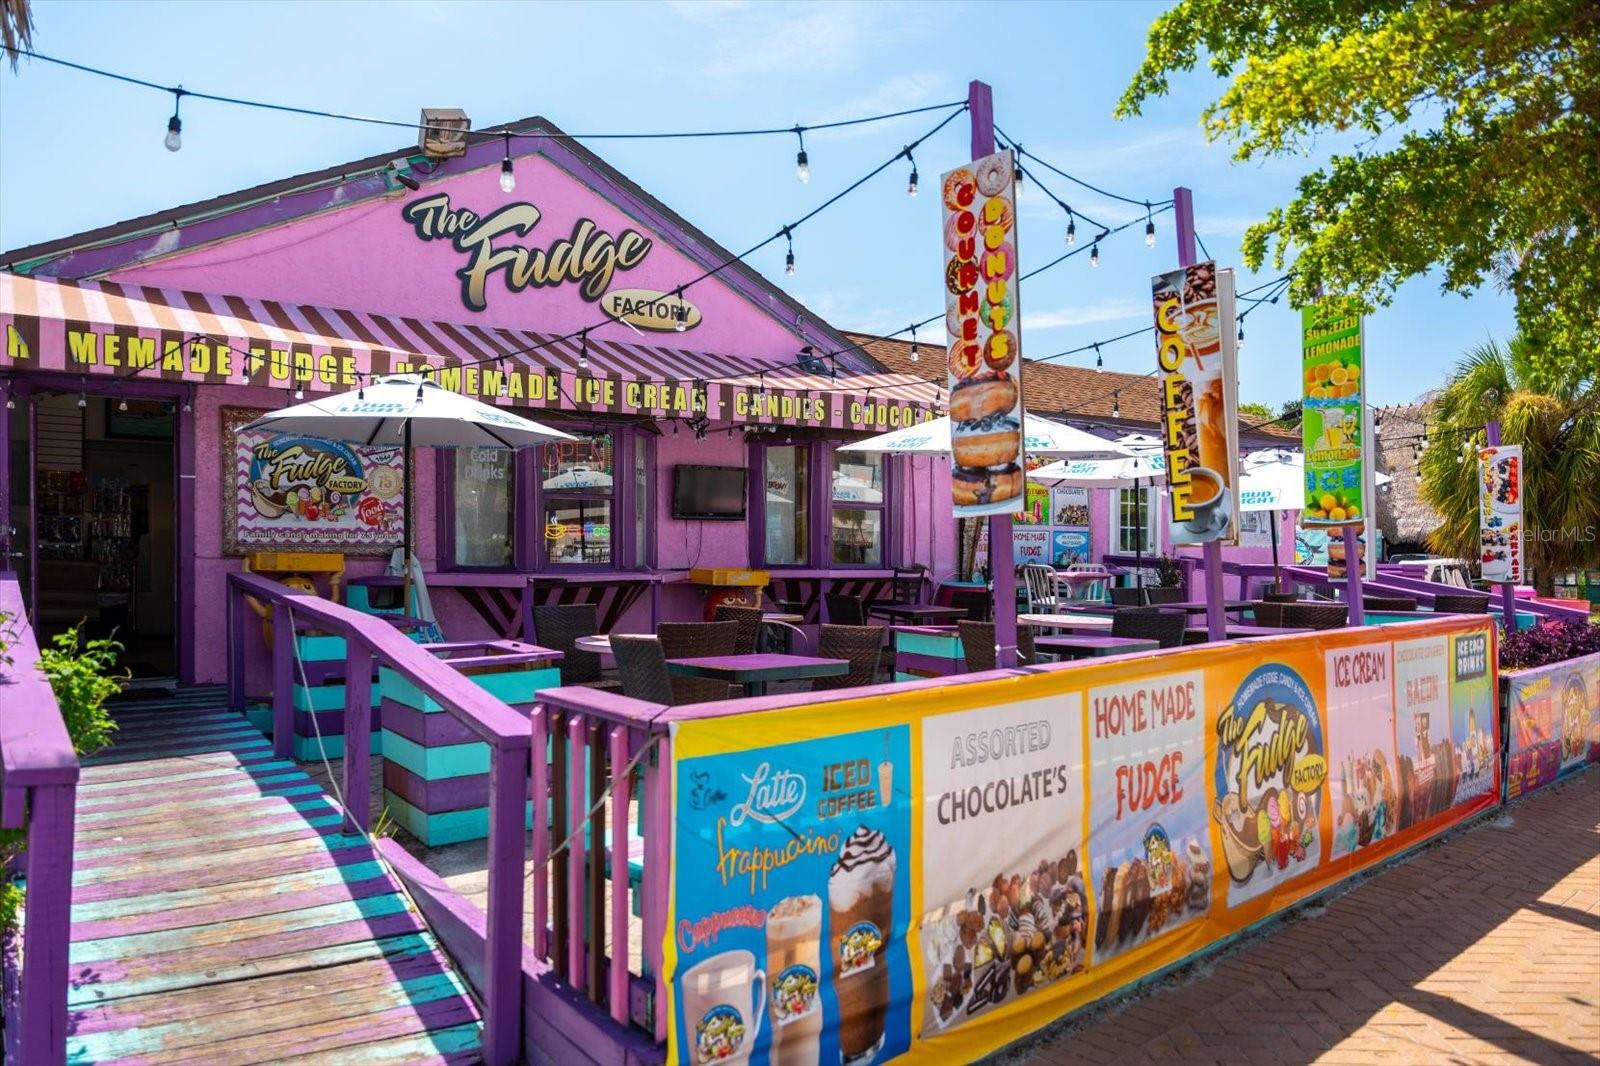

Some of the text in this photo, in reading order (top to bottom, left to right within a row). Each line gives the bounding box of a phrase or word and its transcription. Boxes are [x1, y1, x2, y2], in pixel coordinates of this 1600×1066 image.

[403, 193, 478, 240] The
[454, 203, 651, 309] Fudge
[956, 183, 1009, 368] GOURMET DONUTS
[612, 296, 693, 324] FACTORY
[1304, 334, 1360, 360] LEMONADE
[251, 352, 357, 385] FUDGE
[575, 377, 615, 405] ICE
[736, 392, 825, 421] CANDIES
[851, 402, 950, 427] CHOCO
[1156, 298, 1196, 522] COFFEE
[254, 443, 280, 459] The
[471, 447, 498, 462] Cold
[543, 440, 605, 468] OPEN
[270, 446, 347, 490] Fudge
[328, 479, 363, 489] FACTORY
[1307, 467, 1360, 492] ICE
[361, 501, 384, 523] food
[309, 530, 343, 541] making
[345, 530, 358, 540] for
[1013, 532, 1029, 541] HOME
[1020, 546, 1042, 557] FUDGE
[1457, 638, 1484, 656] ICE COLD
[1333, 651, 1386, 688] ICE CREAM
[1457, 655, 1484, 675] DRINKS
[1094, 681, 1195, 739] HOME MADE
[1218, 705, 1244, 748] The
[950, 720, 1051, 770] ASSORTED
[1236, 701, 1309, 814] Fudge
[822, 758, 872, 792] ICED
[1115, 751, 1184, 820] FUDGE
[1294, 760, 1324, 786] FACTORY
[730, 762, 806, 827] Latte
[817, 790, 878, 820] COFFEE
[937, 765, 1067, 825] CHOCOLATE'S
